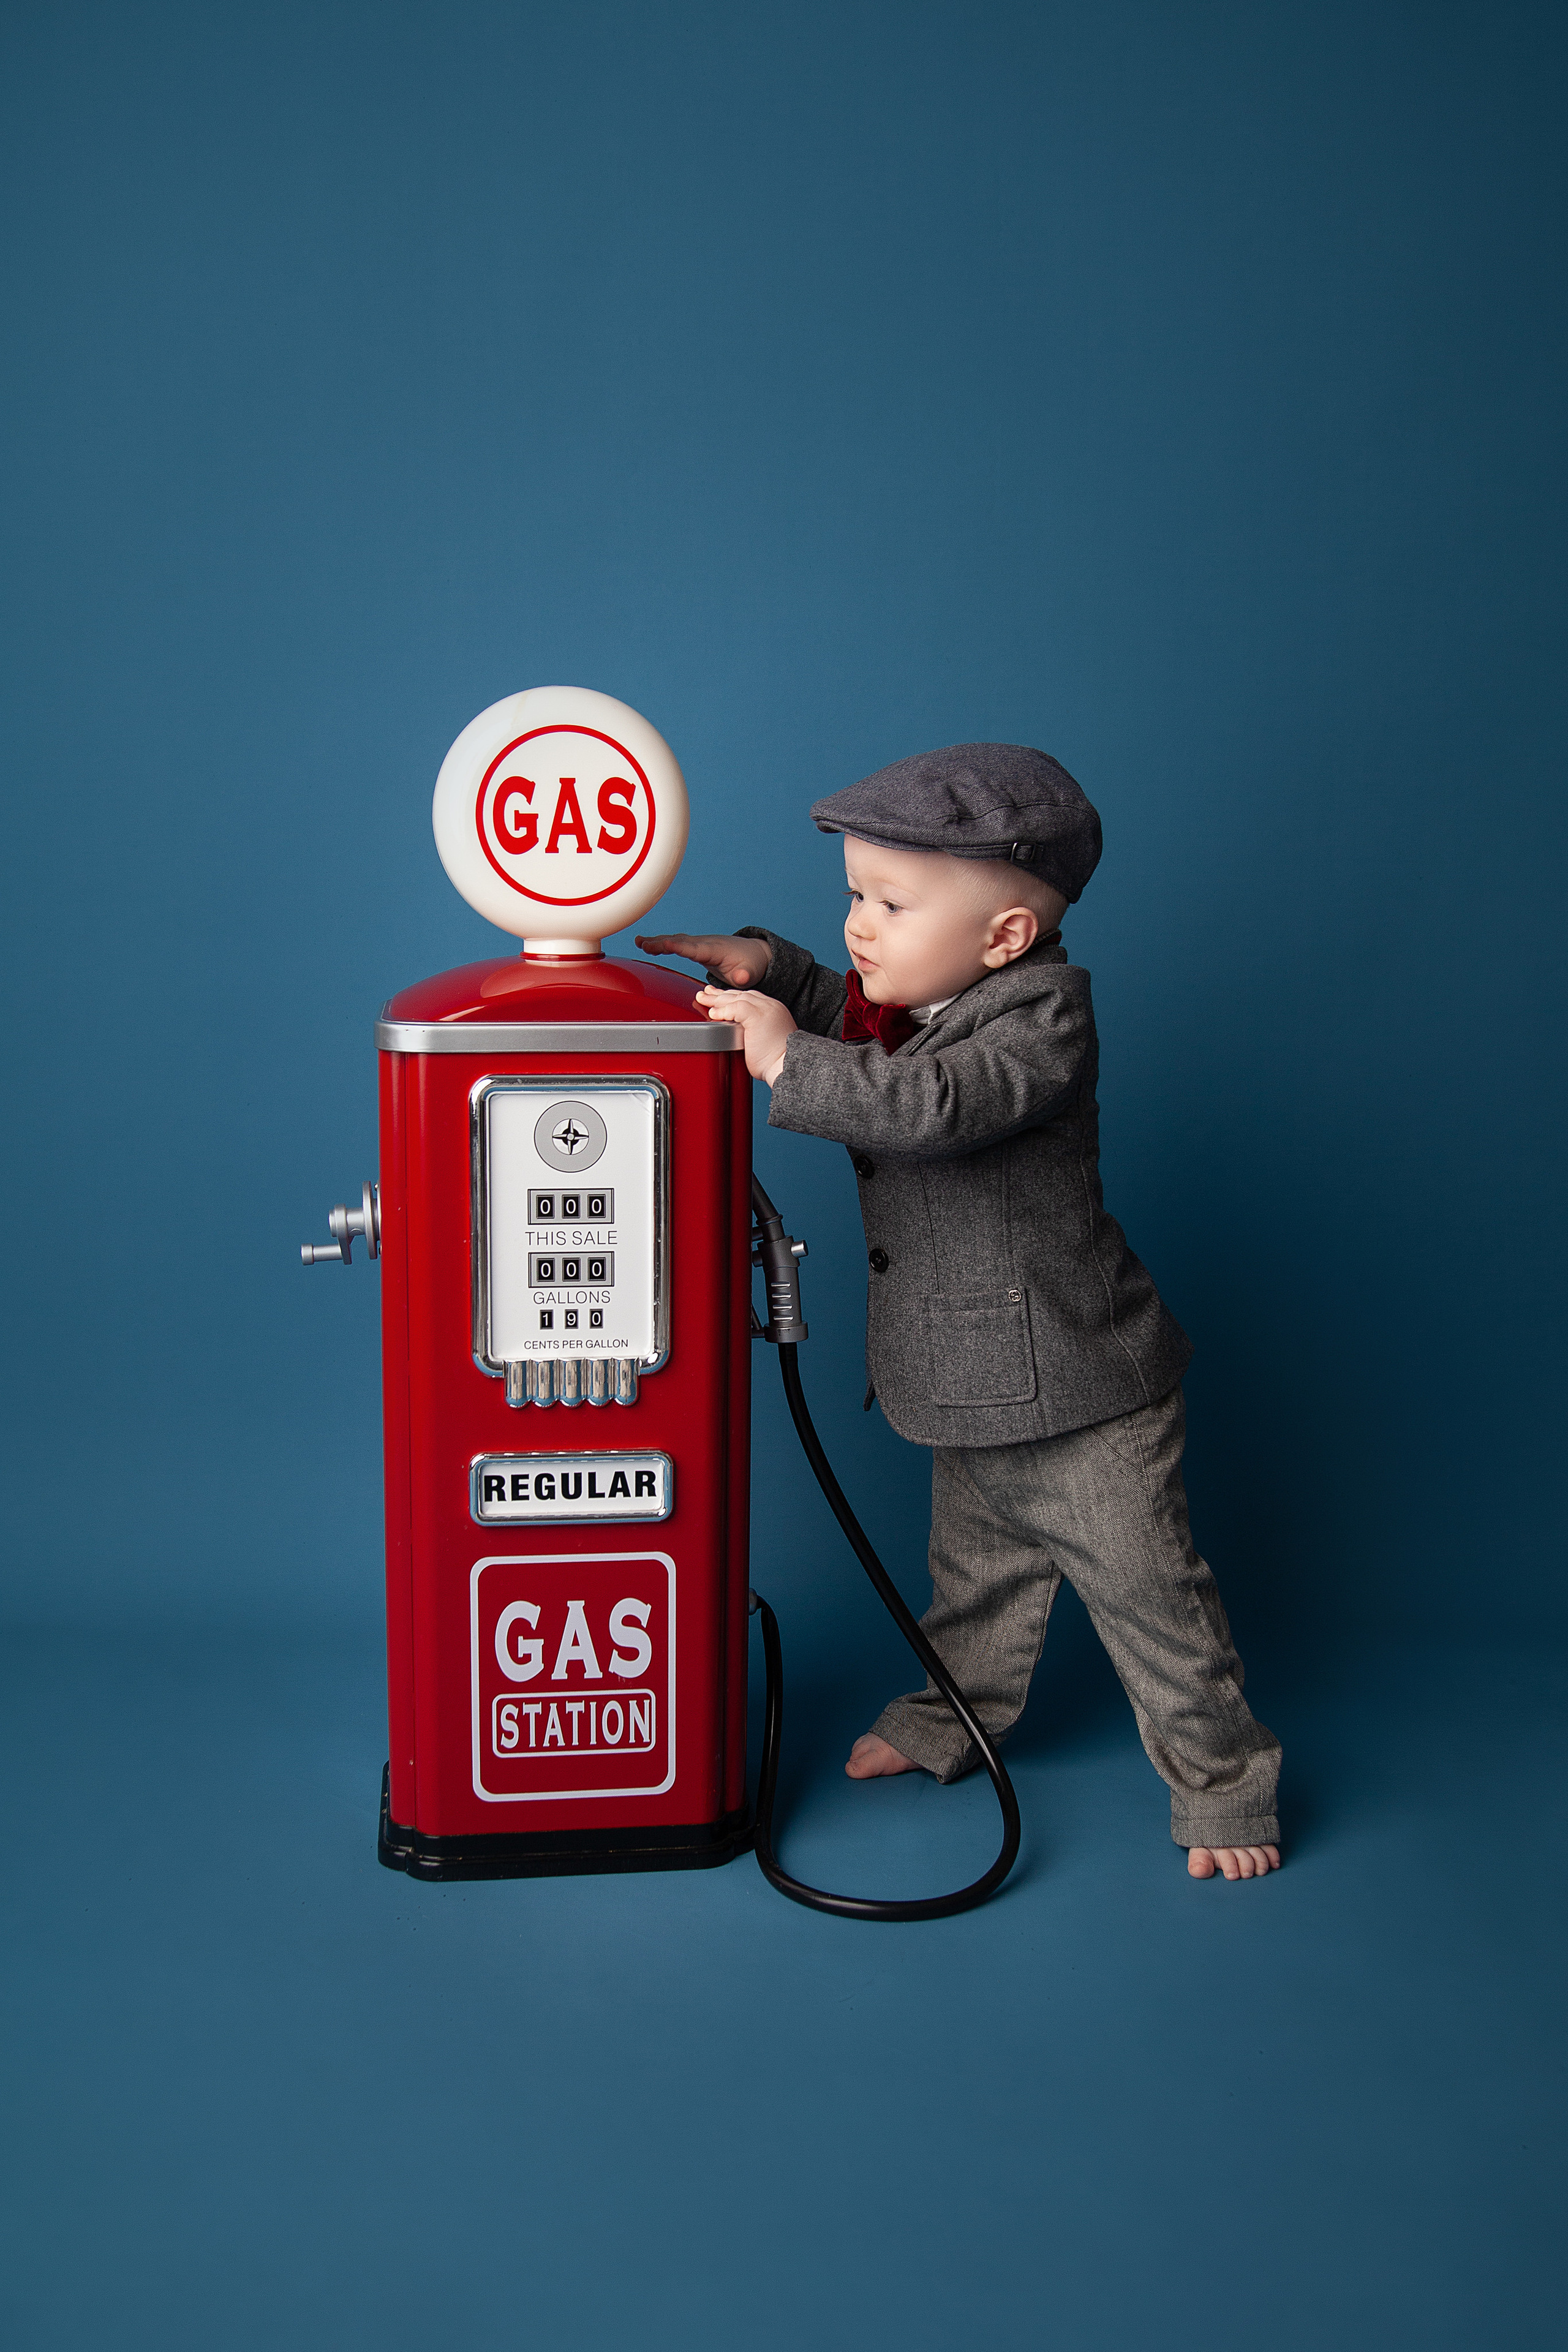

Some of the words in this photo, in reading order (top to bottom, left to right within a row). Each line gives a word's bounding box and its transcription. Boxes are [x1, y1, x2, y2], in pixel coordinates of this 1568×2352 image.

[492, 776, 638, 855] GAS
[524, 1231, 567, 1246] THIS
[572, 1230, 618, 1245] SALE
[533, 1291, 611, 1305] GALLONS
[524, 1340, 560, 1349] CENTS
[562, 1340, 583, 1349] PER
[586, 1339, 628, 1349] GALLON
[484, 1470, 657, 1502] REGULAR
[494, 1597, 652, 1683] GAS
[500, 1699, 650, 1749] STATION
